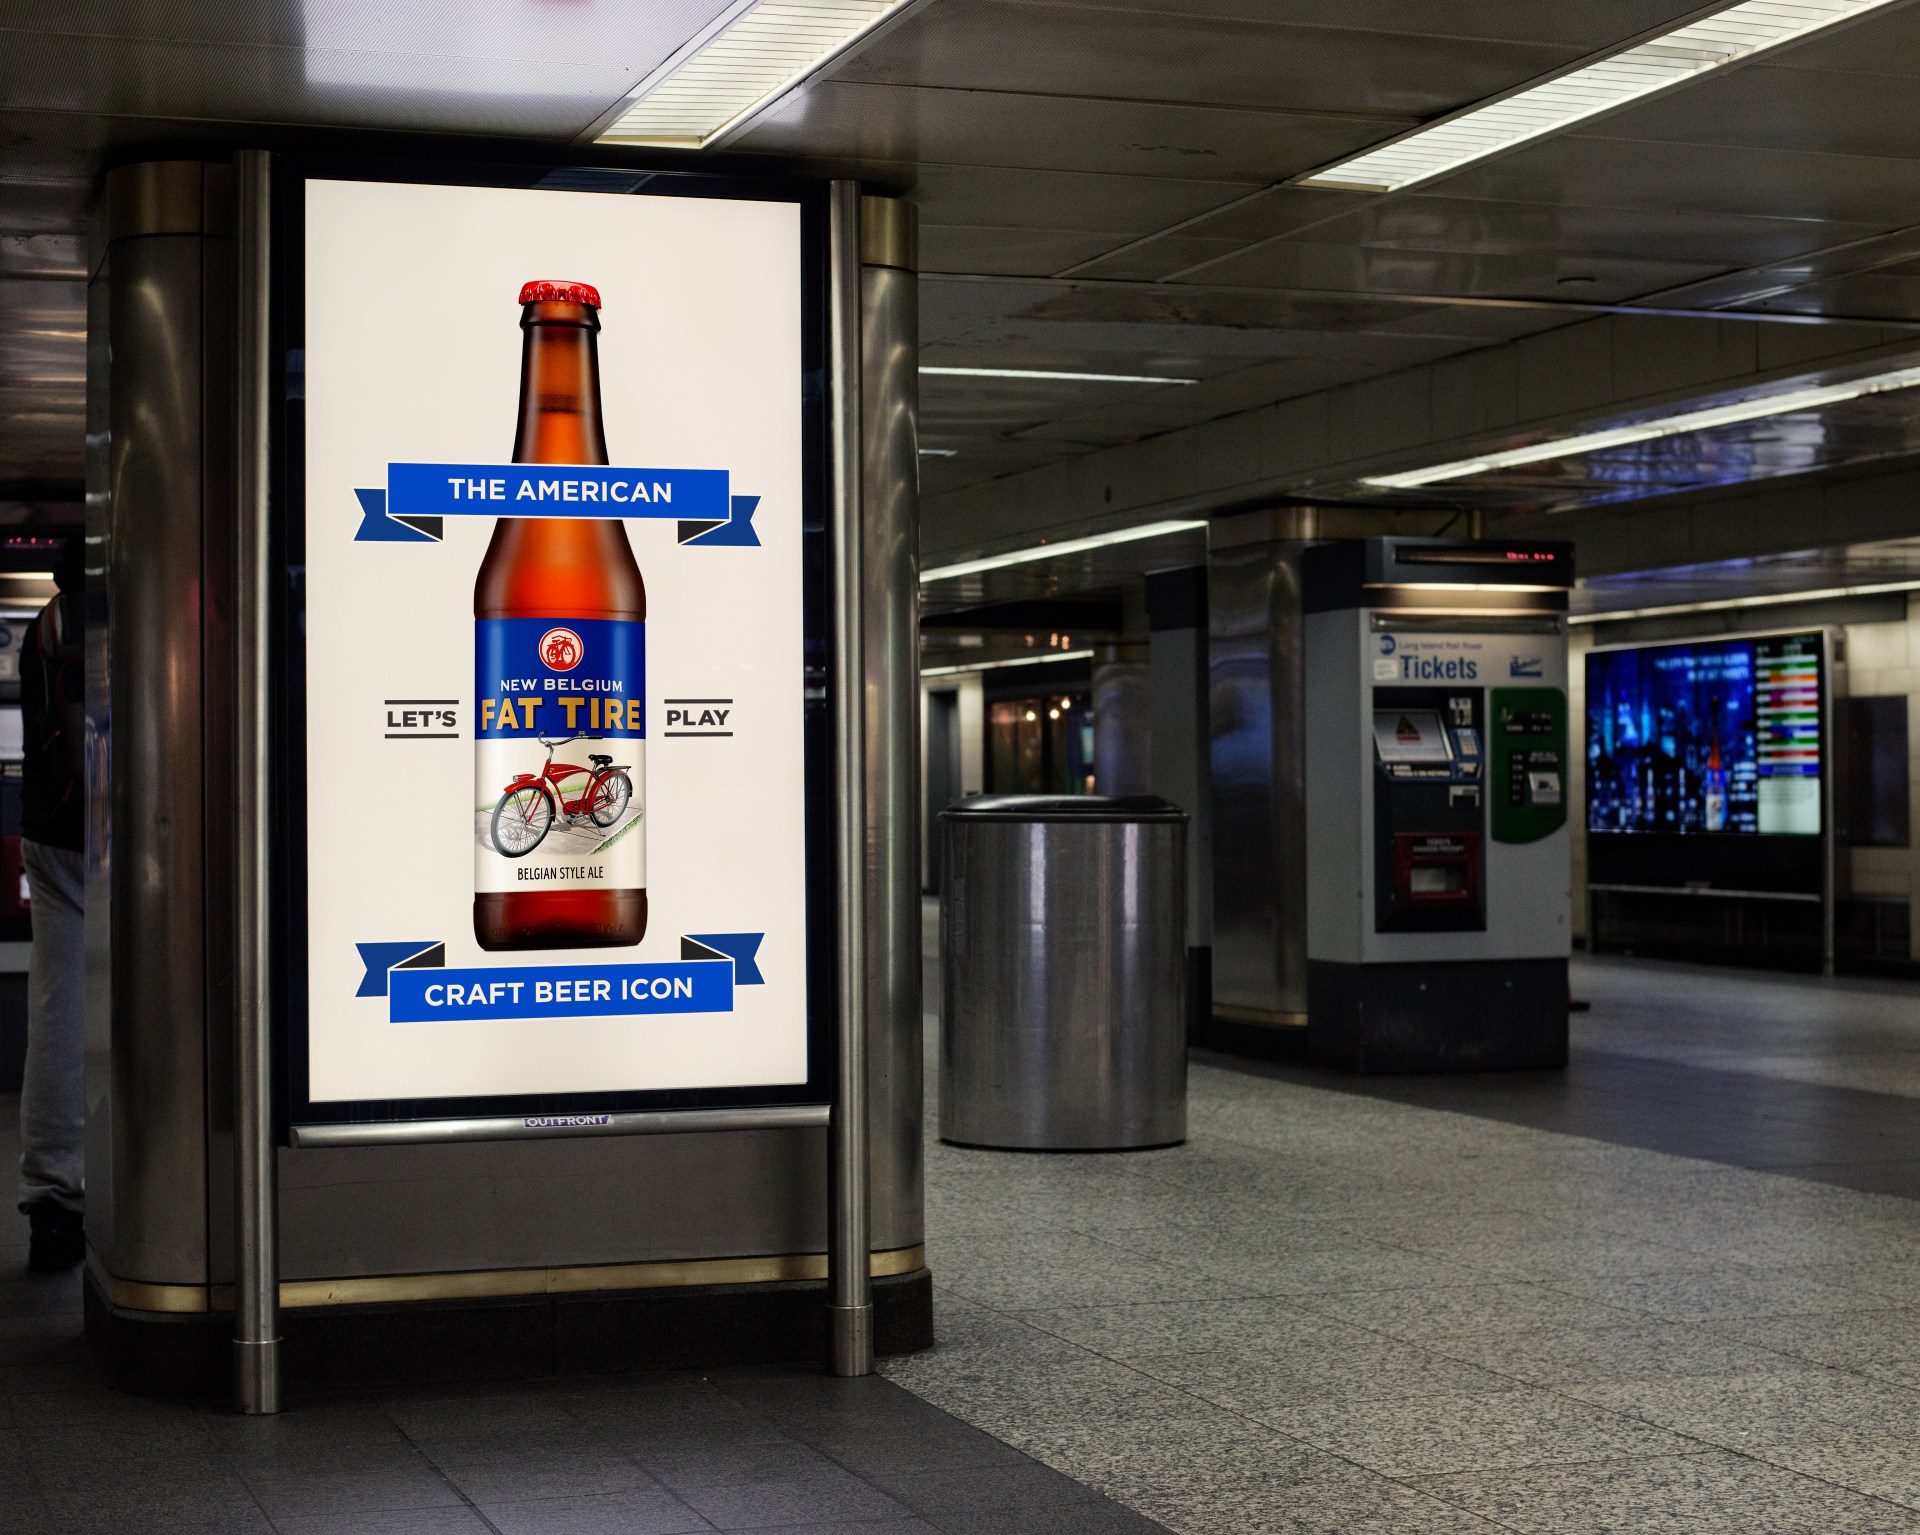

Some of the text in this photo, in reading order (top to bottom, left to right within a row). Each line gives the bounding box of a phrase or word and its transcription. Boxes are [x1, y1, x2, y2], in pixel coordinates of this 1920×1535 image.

[448, 478, 672, 503] THE AMERICAN
[1400, 655, 1478, 680] Tickets
[500, 678, 623, 692] NEW BELGIUM
[387, 710, 457, 728] LET'S
[481, 697, 642, 731] FAT TIRE
[667, 709, 730, 727] PLAY
[517, 866, 604, 881] BELGIAN STYLE ALE
[424, 977, 693, 1007] CRAFT BEER ICON
[527, 1116, 605, 1127] OUTFRONT
